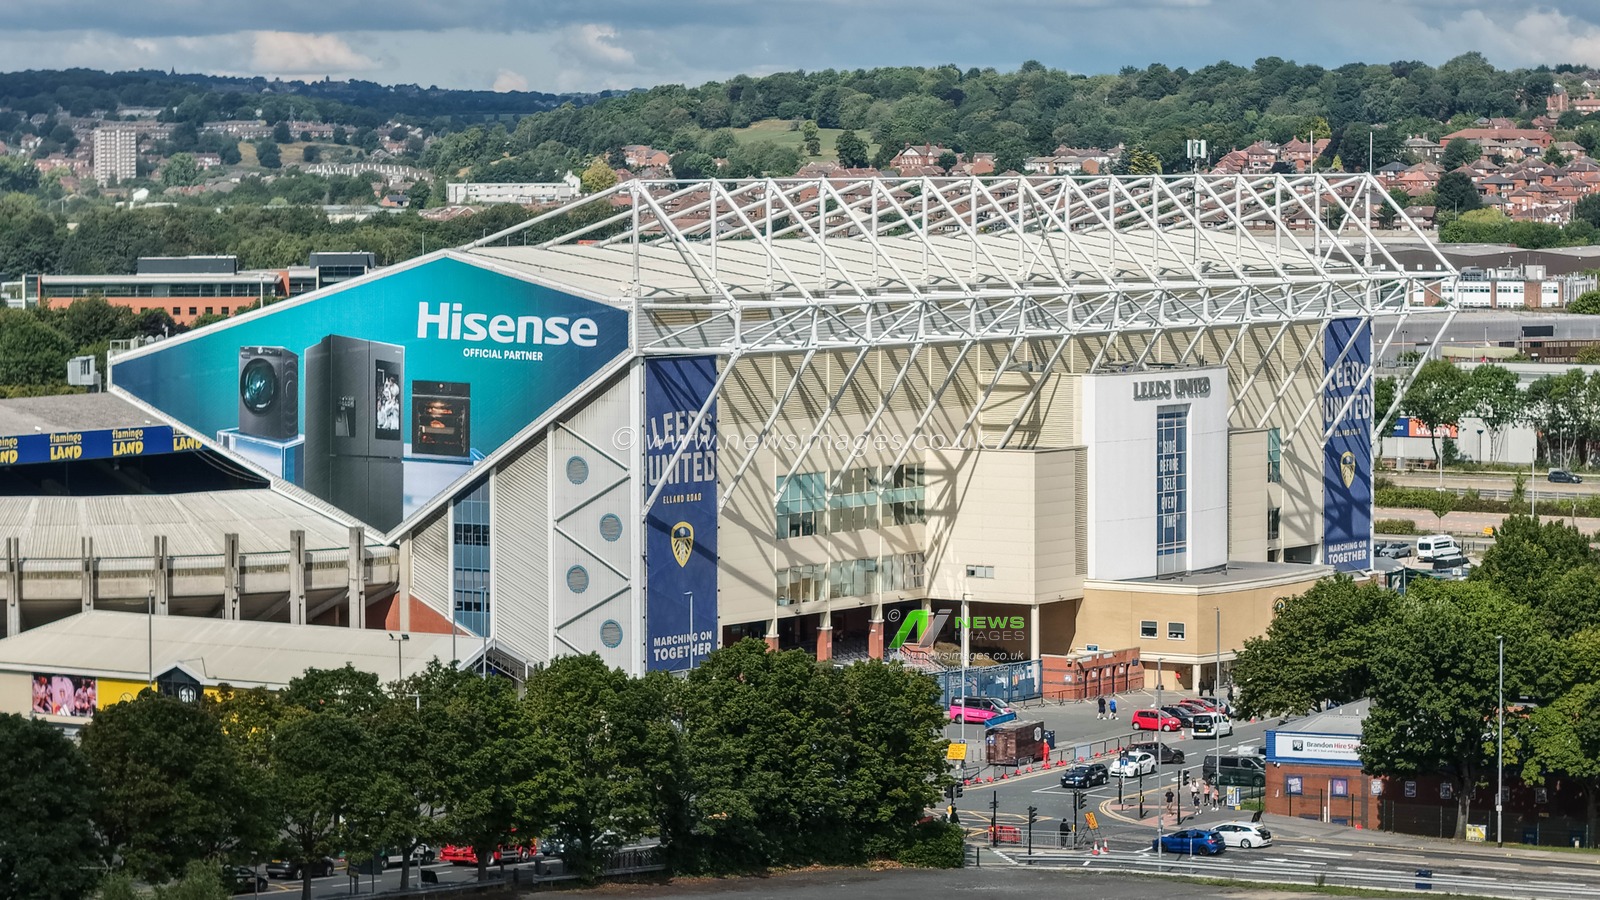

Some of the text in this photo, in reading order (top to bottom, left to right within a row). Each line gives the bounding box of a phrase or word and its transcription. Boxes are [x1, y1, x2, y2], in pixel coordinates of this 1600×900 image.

[417, 301, 599, 348] Hisense
[463, 347, 543, 361] OFFICIAL PARTNER
[1133, 377, 1211, 399] LEEDS UNITED
[112, 427, 144, 439] flamingo
[650, 410, 713, 448] LEEDS
[49, 432, 82, 444] flamingo
[50, 445, 83, 461] LAND
[112, 440, 144, 456] LAND
[648, 450, 716, 486] UNITED
[663, 492, 702, 504] ELLAND ROAD
[1328, 540, 1367, 553] MARCHING ON
[1328, 549, 1367, 565] TOGETHER
[653, 630, 712, 647] MARCHING ON
[653, 642, 712, 662] TOGETHER
